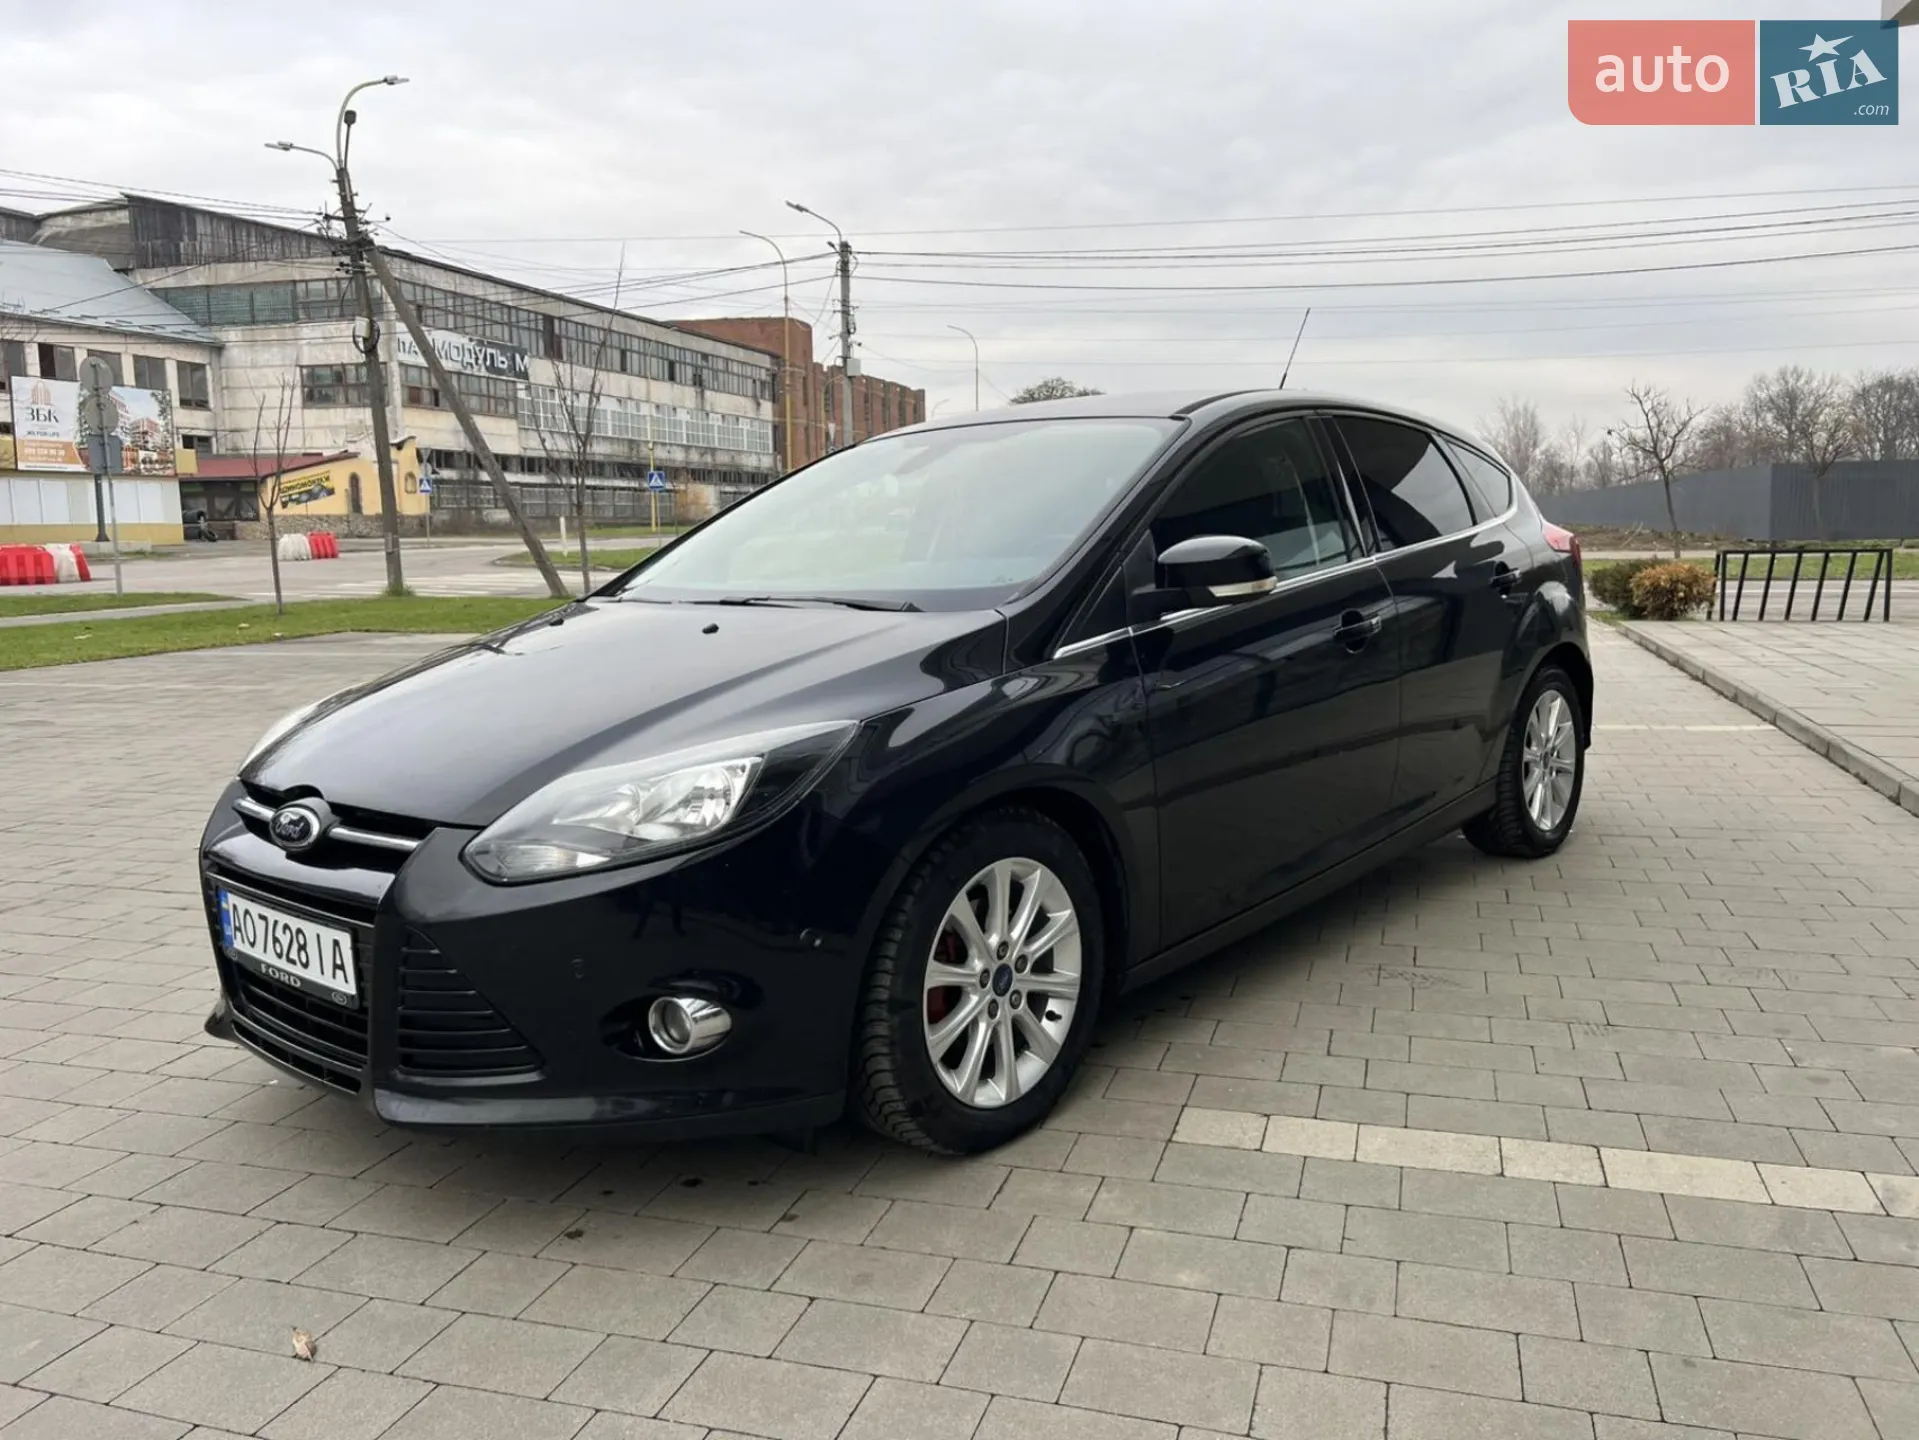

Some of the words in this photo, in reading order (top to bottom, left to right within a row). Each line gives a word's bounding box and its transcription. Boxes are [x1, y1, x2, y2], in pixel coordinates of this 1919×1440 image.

[432, 338, 508, 370] МОДУЛЬ
[25, 407, 59, 423] ЗБК
[261, 963, 301, 988] FORD
